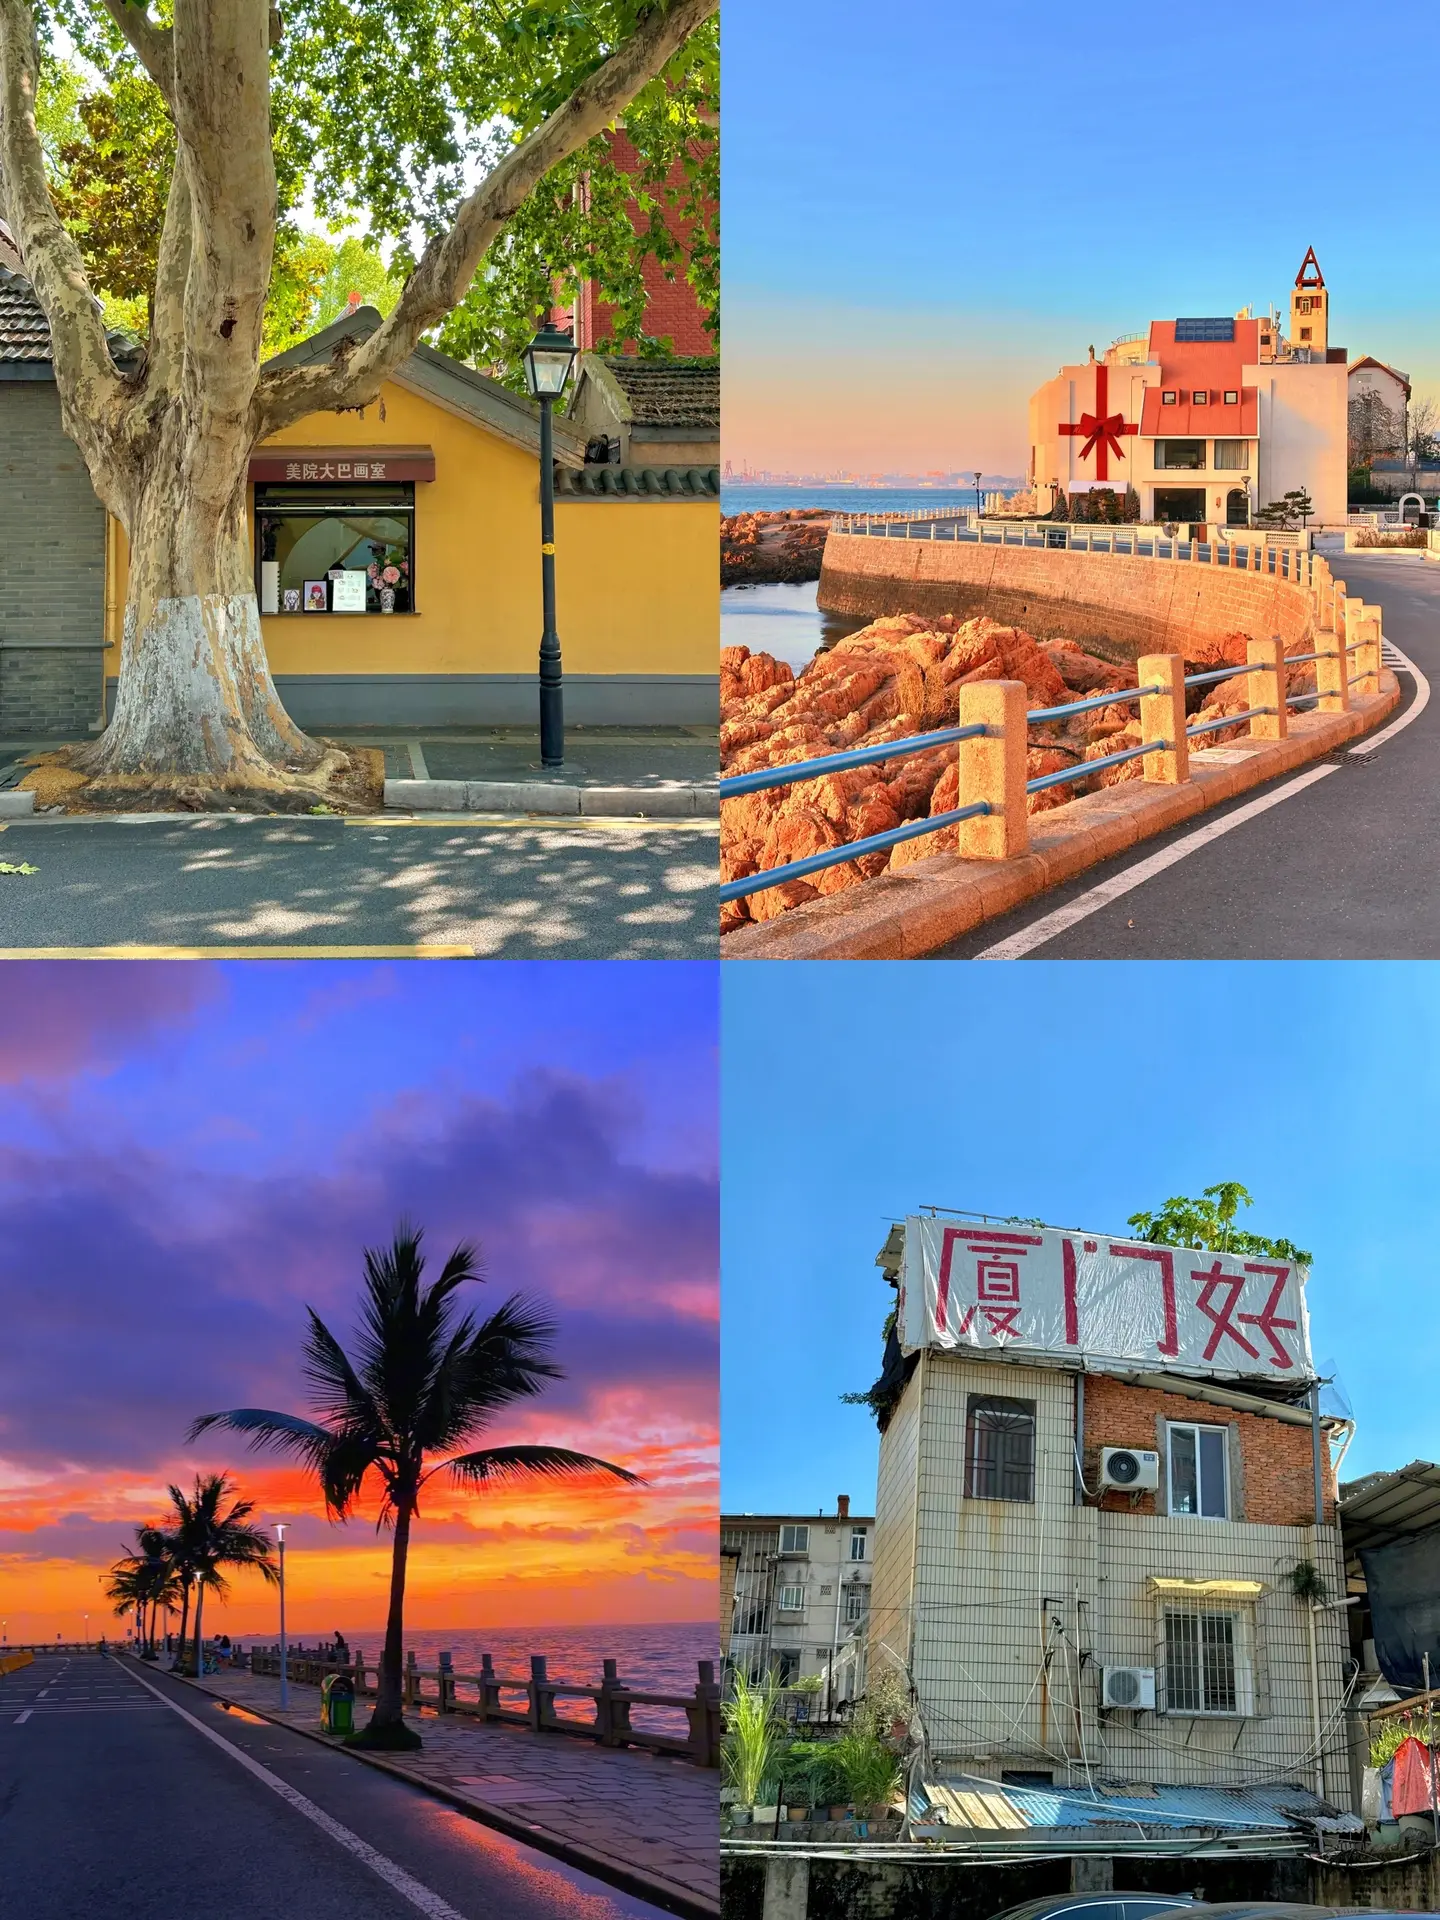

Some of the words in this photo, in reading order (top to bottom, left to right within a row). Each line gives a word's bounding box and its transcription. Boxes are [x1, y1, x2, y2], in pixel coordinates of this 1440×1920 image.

[286, 463, 386, 480] 美院大巴画室
[936, 1228, 1297, 1369] 厦门好
